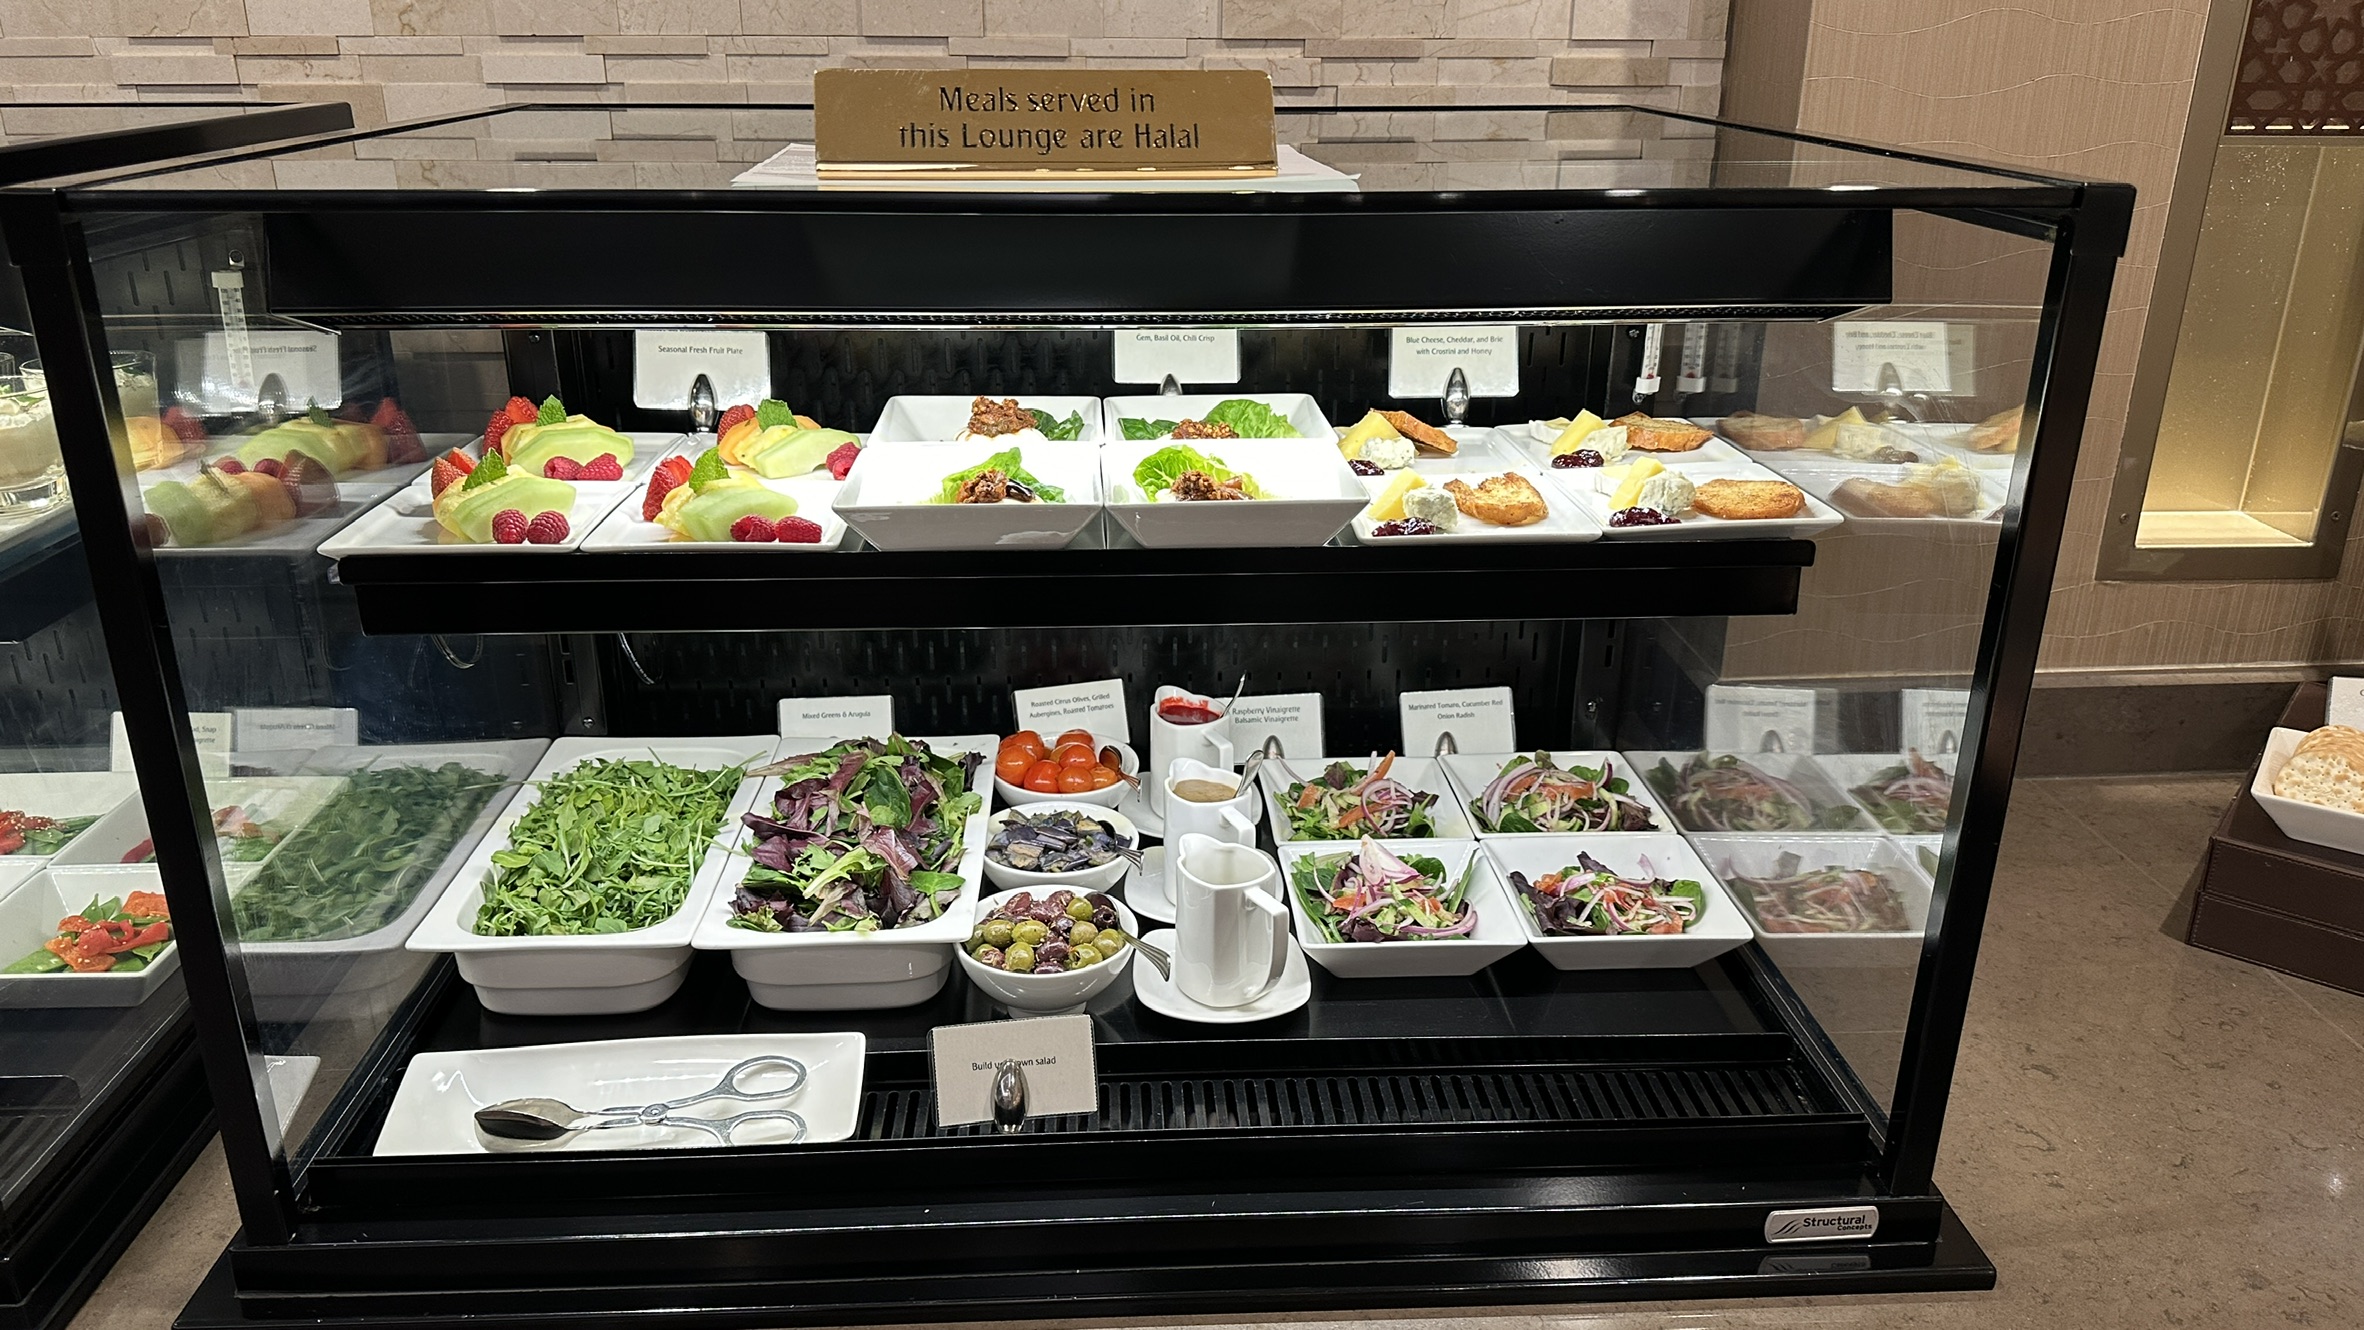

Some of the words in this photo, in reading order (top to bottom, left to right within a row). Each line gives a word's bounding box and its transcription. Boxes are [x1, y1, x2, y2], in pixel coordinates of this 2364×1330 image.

[940, 87, 1018, 112] Meals
[1028, 87, 1119, 113] served
[1131, 87, 1155, 112] in
[899, 123, 949, 149] this
[962, 123, 1068, 155] Lounge
[1080, 128, 1124, 149] are
[1135, 123, 1200, 149] Halal
[1136, 334, 1152, 342] Gem,
[1170, 334, 1182, 342] Oil,
[1198, 334, 1215, 342] Crisp
[1421, 336, 1445, 344] Cheese,
[1446, 336, 1475, 344] Cheddar,
[1490, 335, 1503, 343] Brie
[658, 345, 688, 353] Seasonal
[689, 346, 707, 354] Fresh
[709, 346, 725, 354] Fruit
[726, 347, 743, 355] Plate
[1431, 347, 1456, 355] Crostini
[1471, 348, 1493, 356] Honey
[1031, 699, 1053, 708] Roasted
[1091, 693, 1111, 701] Grilled
[1462, 700, 1490, 708] Cucumber
[1063, 706, 1086, 715] Roasted
[1087, 703, 1115, 712] Tomatoes
[1232, 707, 1265, 715] Raspberry
[1265, 706, 1301, 715] Vinaigrette
[821, 711, 841, 719] Greens
[848, 710, 871, 719] Arugula
[1437, 712, 1455, 720] Onion
[1234, 716, 1263, 724] Balsamic
[1263, 715, 1299, 724] Vinaigrette
[972, 1061, 993, 1071] Build
[1035, 1056, 1057, 1065] salad
[1802, 1215, 1866, 1227] Structural
[1837, 1223, 1872, 1231] Concepts
